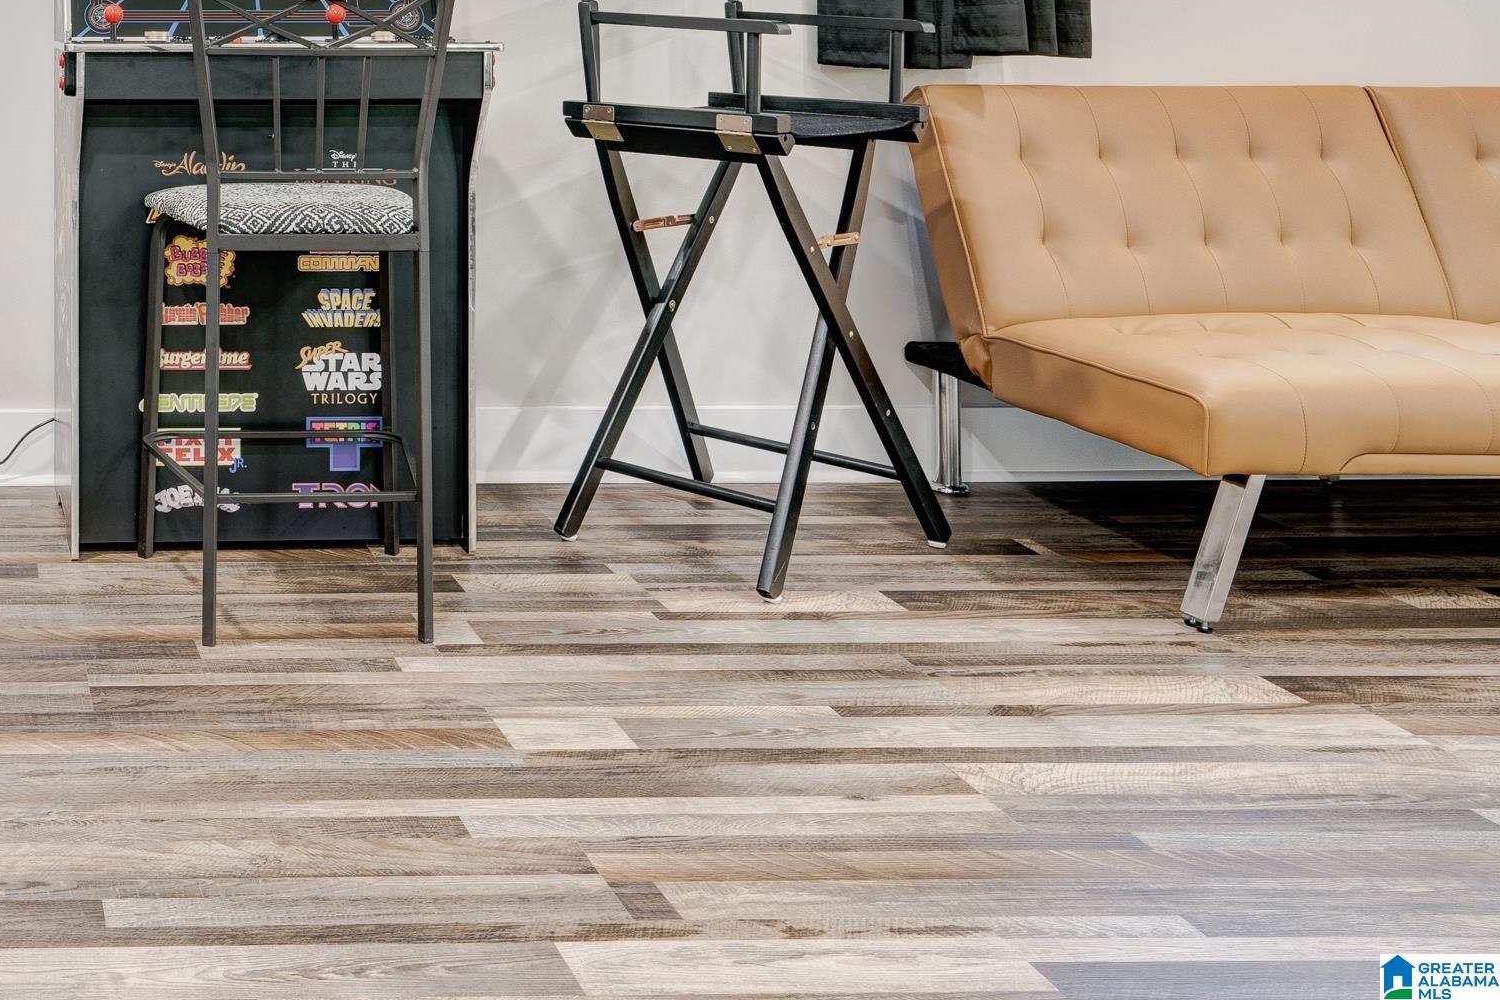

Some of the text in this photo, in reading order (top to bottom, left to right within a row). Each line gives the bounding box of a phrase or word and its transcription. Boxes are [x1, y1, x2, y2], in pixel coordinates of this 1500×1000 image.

[298, 255, 379, 271] COMMAN
[317, 289, 376, 311] SPACE
[295, 340, 349, 369] SUPER
[302, 352, 382, 371] STAR
[302, 372, 382, 390] WARS
[311, 393, 377, 404] TRILOGY
